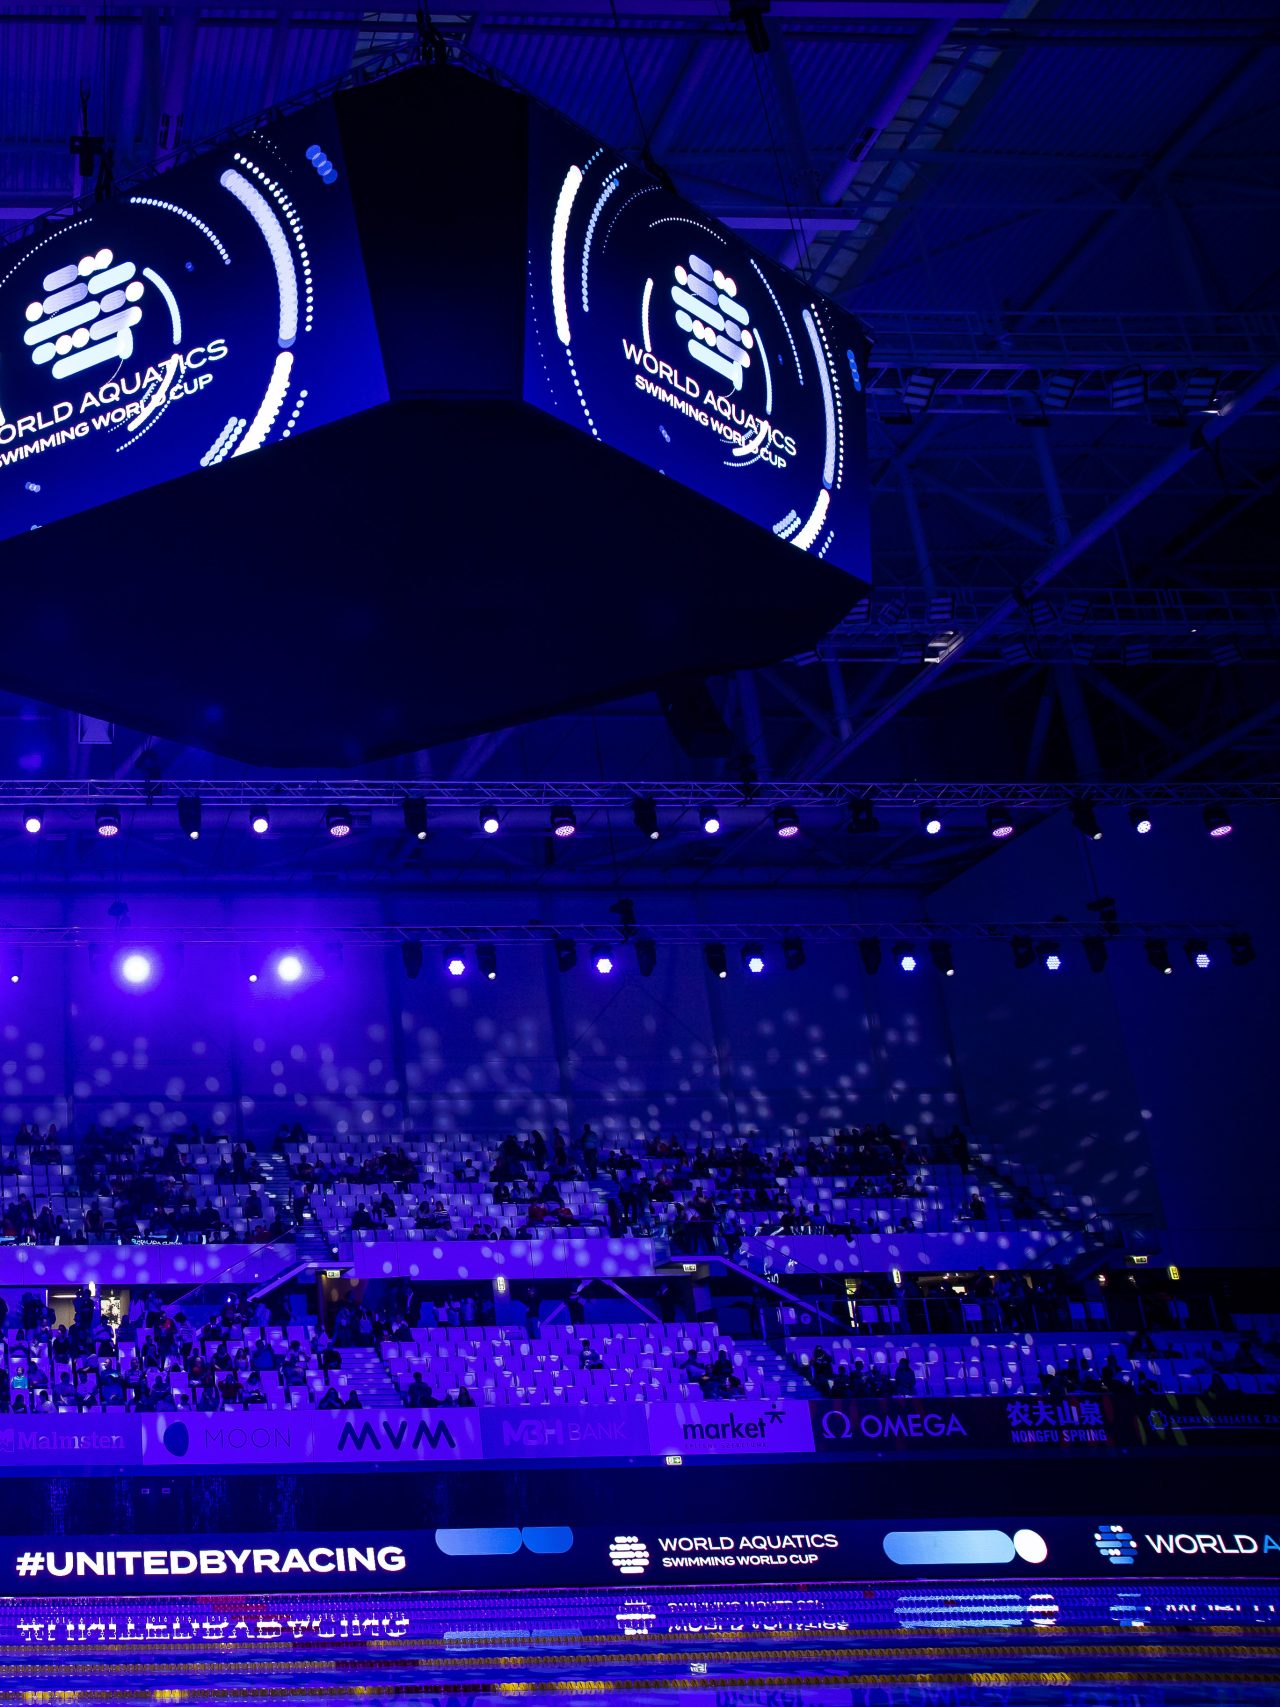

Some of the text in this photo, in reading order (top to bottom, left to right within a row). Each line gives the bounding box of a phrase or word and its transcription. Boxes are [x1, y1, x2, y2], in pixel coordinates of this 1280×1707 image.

[622, 338, 701, 398] WORLD
[168, 373, 214, 401] CUP
[635, 374, 787, 469] SWIMMING WORL CUP
[682, 1411, 767, 1441] market
[859, 1412, 968, 1438] OMEGA
[1006, 1399, 1105, 1427] 农夫山泉
[18, 1430, 126, 1450] Malmsten
[204, 1426, 292, 1450] MOON
[336, 1419, 457, 1451] MVM
[567, 1421, 629, 1442] BANK
[1010, 1428, 1108, 1444] NONGFU SPRING
[658, 1533, 839, 1552] WORLD AQUATICS
[1144, 1533, 1259, 1554] WORLD
[15, 1545, 407, 1577] #UNITEDBYRACING
[662, 1553, 819, 1568] SWIMMING WORLD CUP
